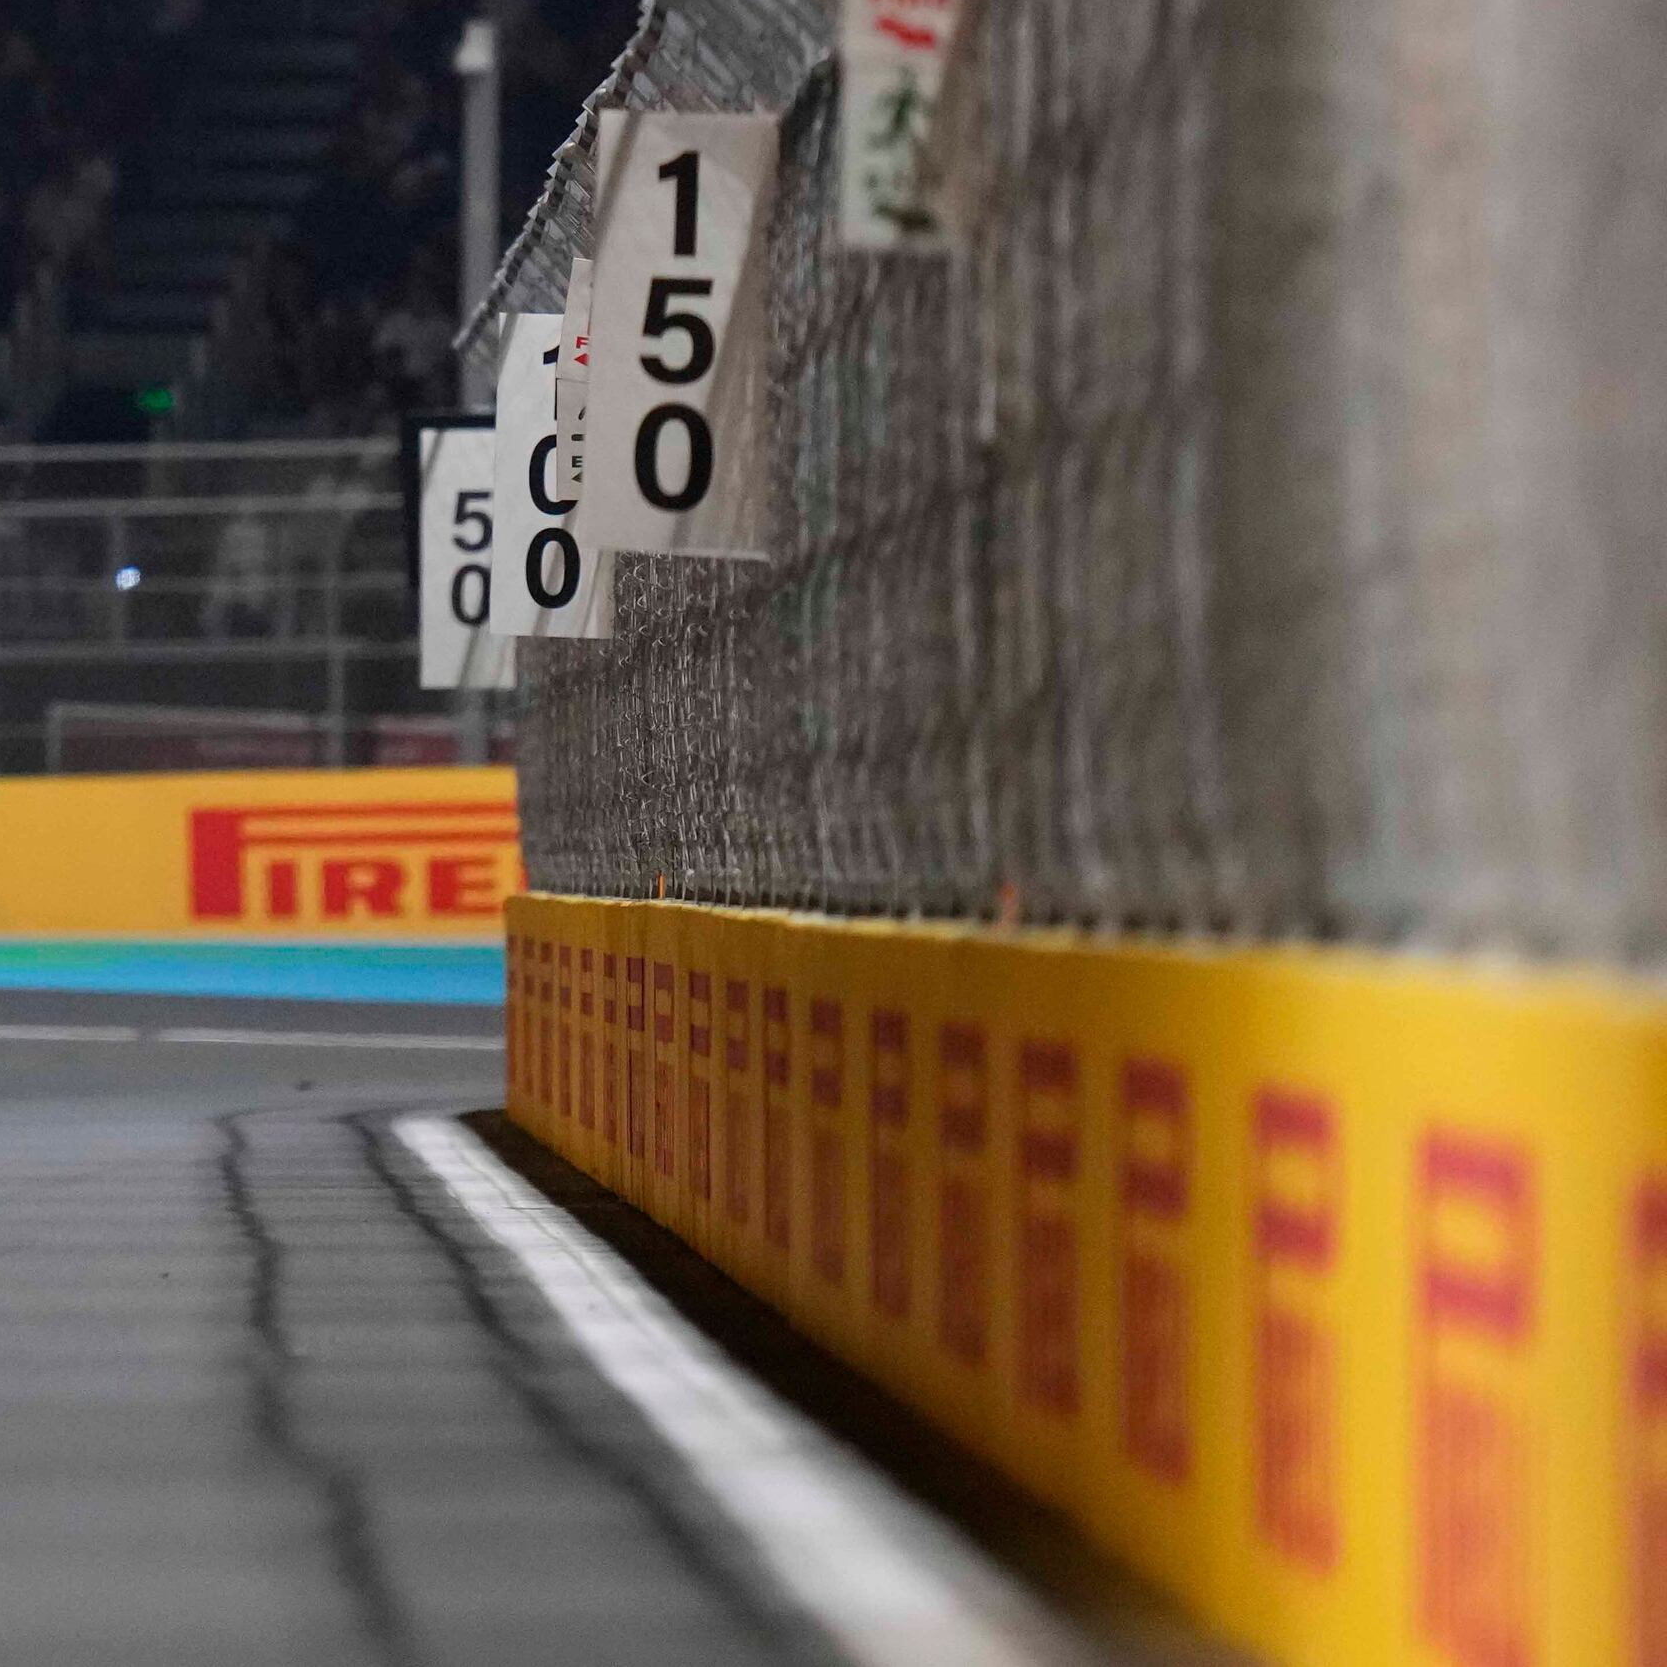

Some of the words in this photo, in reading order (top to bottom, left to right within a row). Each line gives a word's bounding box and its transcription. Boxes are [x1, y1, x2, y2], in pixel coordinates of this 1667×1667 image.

[633, 149, 716, 514] 150
[450, 488, 493, 629] 50
[525, 344, 582, 610] 00
[188, 801, 526, 922] PIRE
